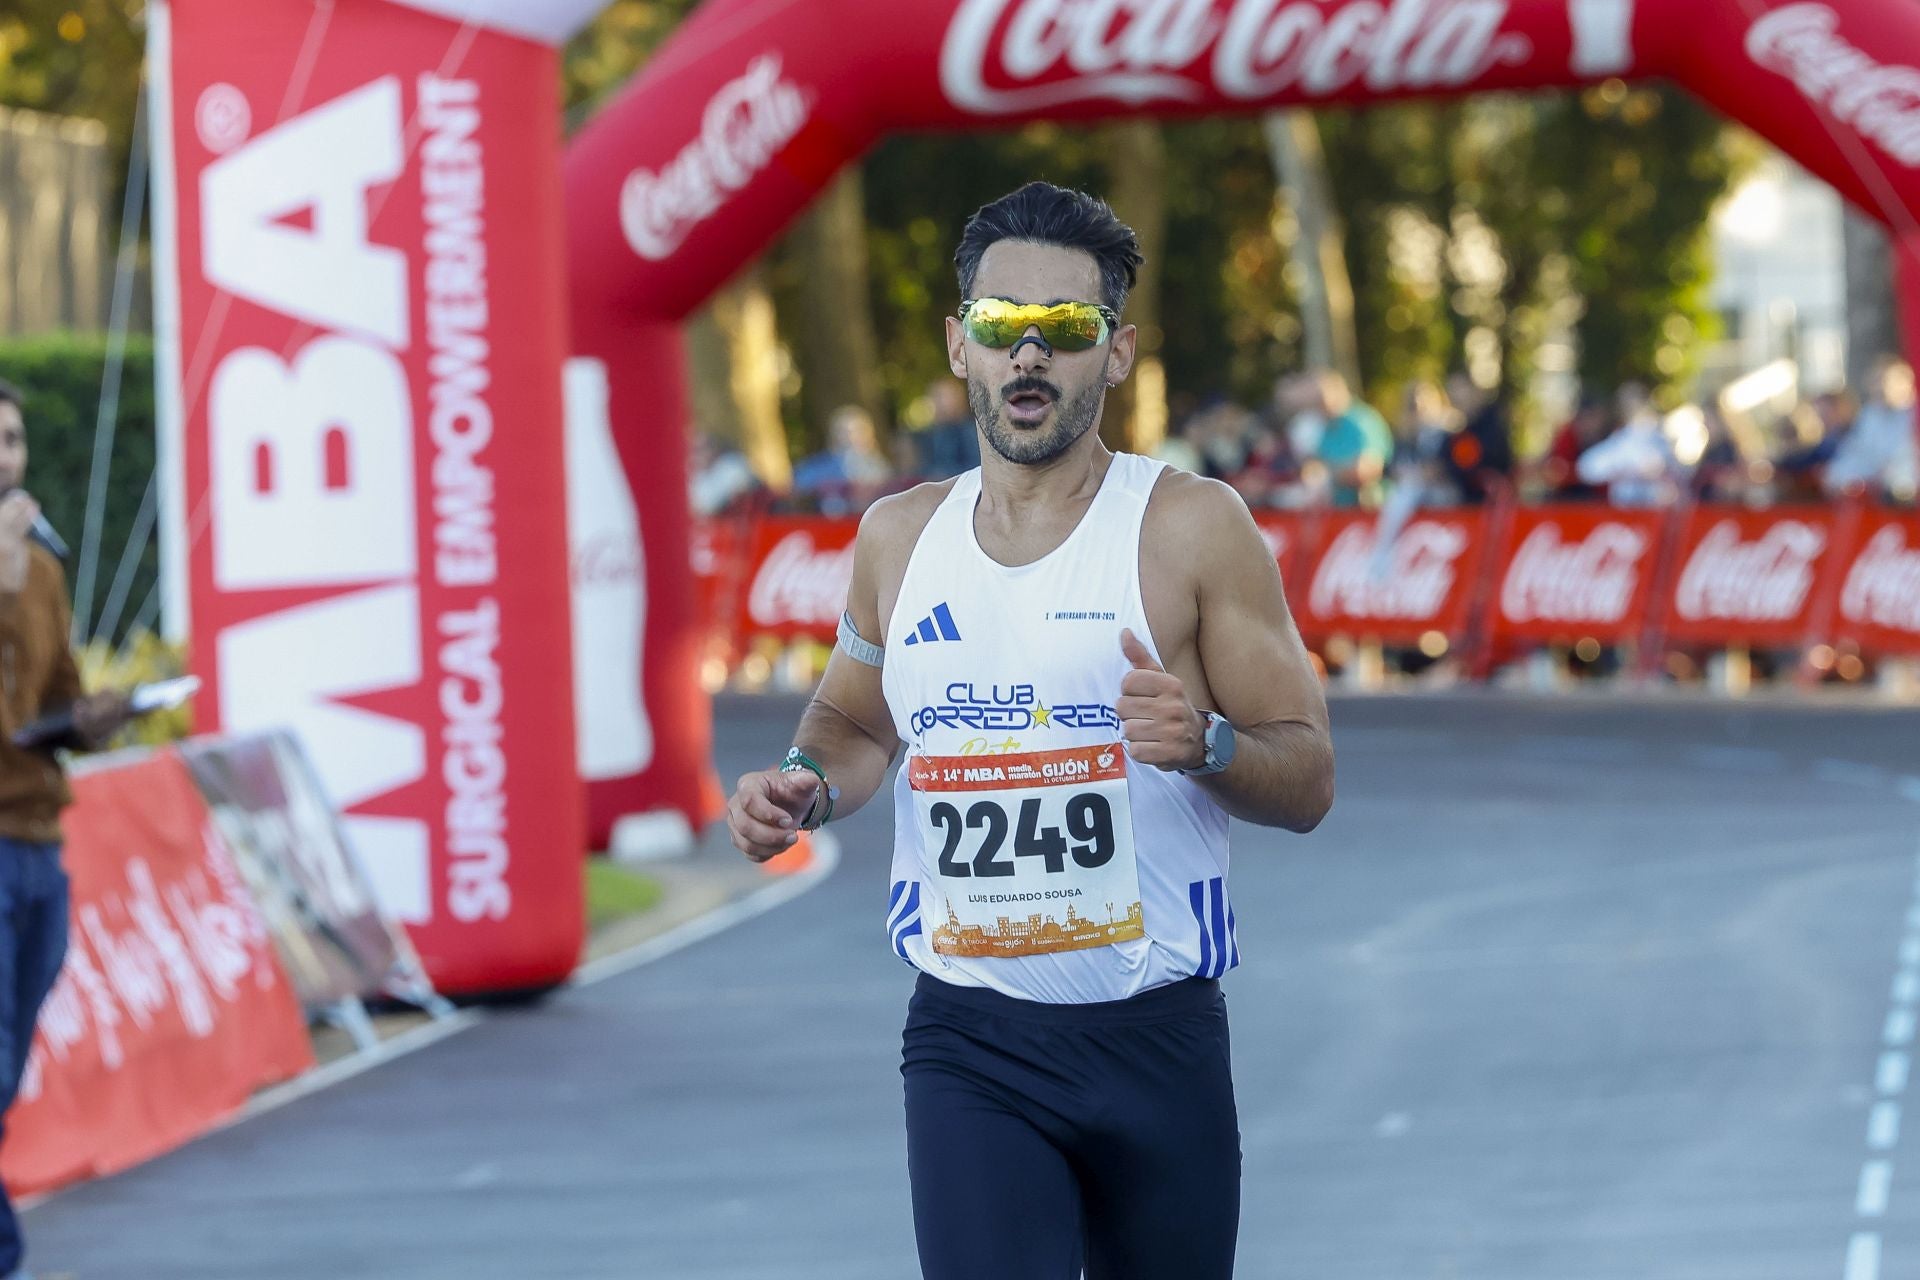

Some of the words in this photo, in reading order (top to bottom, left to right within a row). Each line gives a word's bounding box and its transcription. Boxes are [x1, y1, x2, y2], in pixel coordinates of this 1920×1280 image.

[416, 71, 498, 588] EMPOWERMENT
[198, 74, 433, 926] MBA
[946, 683, 1034, 705] CLUB
[437, 596, 511, 923] SURGICAL
[1008, 763, 1032, 773] media
[1042, 758, 1090, 778] GIJÓN
[964, 767, 1006, 782] MBA
[1008, 770, 1042, 781] maratón
[1051, 775, 1076, 784] OCTUBRE
[930, 792, 1116, 878] 2249
[968, 893, 988, 904] LUIS
[990, 891, 1042, 904] EDUARDO
[1044, 888, 1083, 900] SOUSA
